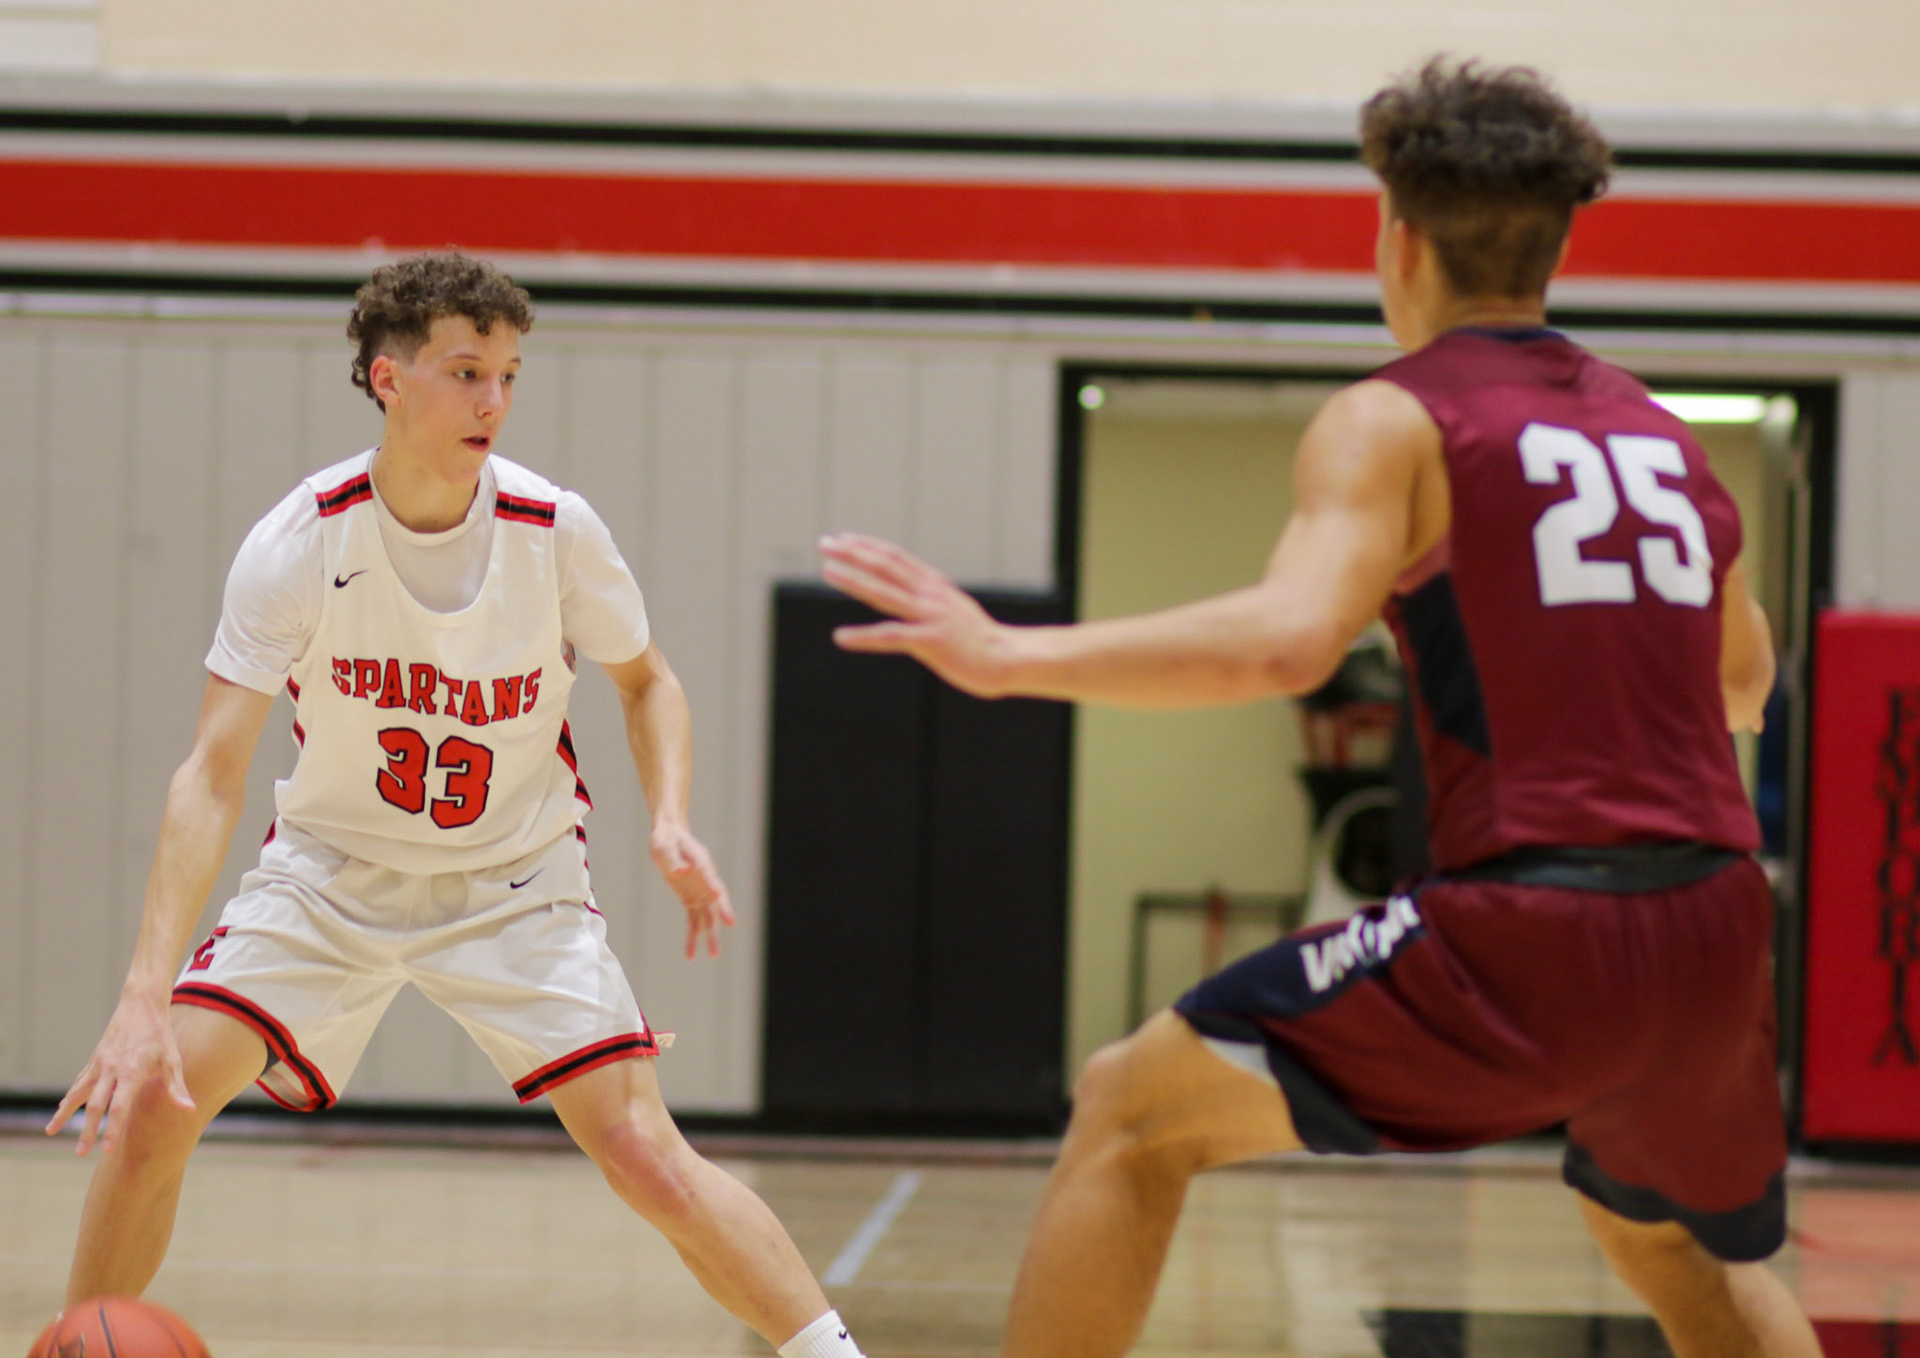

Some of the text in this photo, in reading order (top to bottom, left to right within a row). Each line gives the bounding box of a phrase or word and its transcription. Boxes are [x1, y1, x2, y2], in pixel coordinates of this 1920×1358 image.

[1517, 422, 1713, 607] 25
[332, 656, 542, 727] SPARTANS
[375, 727, 494, 829] 33
